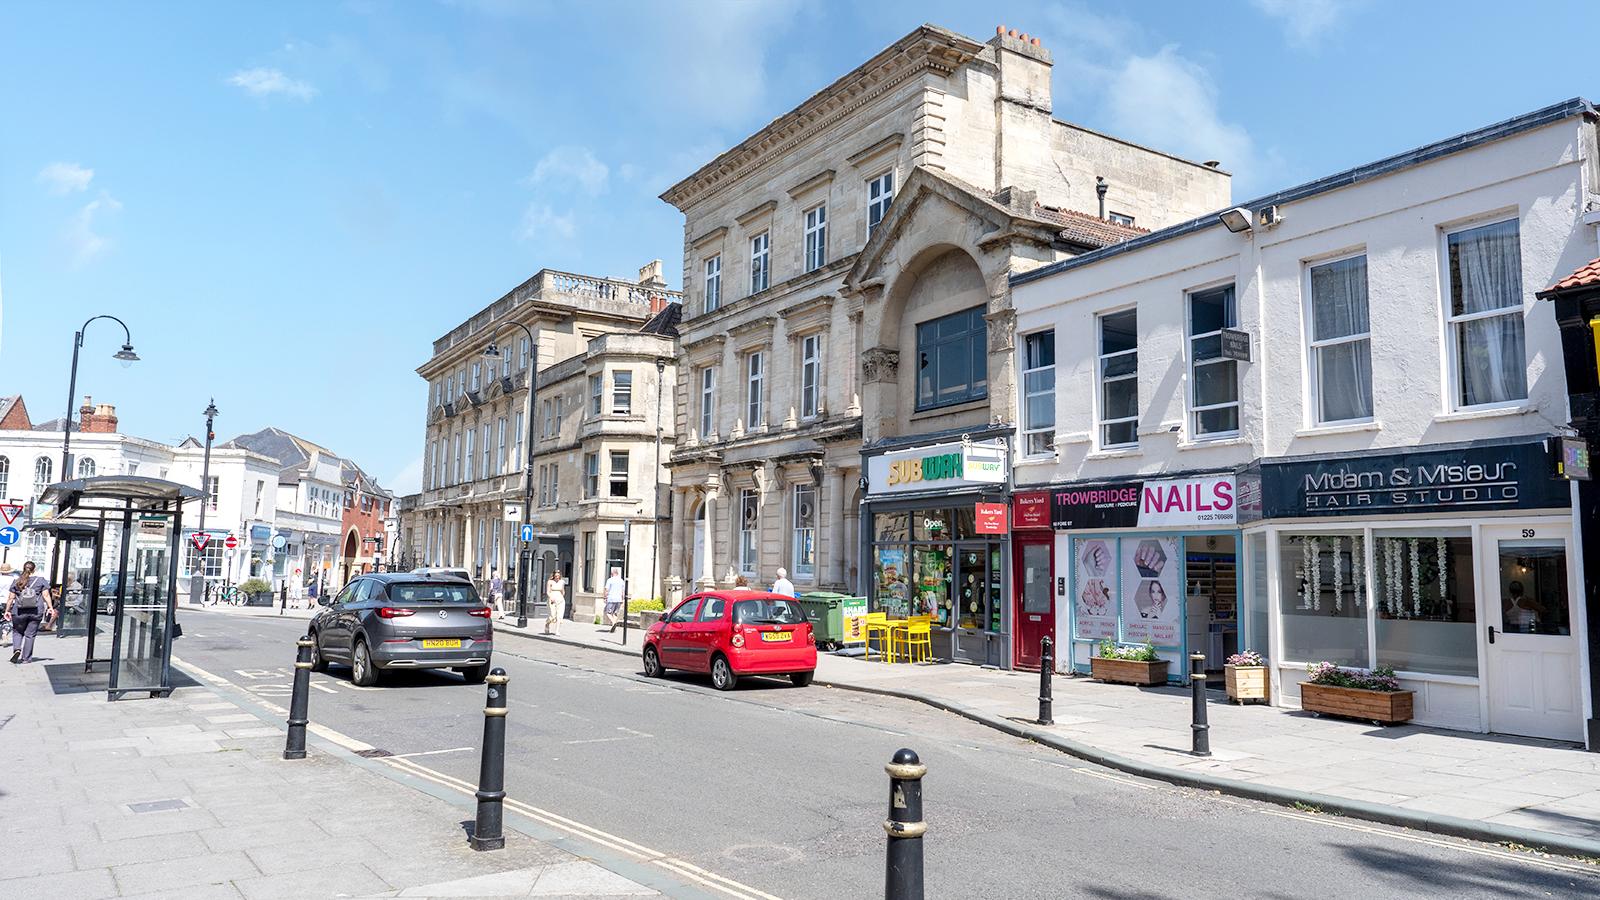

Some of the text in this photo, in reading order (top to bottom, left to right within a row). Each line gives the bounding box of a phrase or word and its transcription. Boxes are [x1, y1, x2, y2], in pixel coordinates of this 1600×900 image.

[1305, 460, 1517, 491] M'dam & M'sieur
[1056, 488, 1137, 505] TROWBRIDGE
[1144, 481, 1234, 514] NAILS
[1306, 486, 1519, 507] HAIR STUDIO
[924, 518, 943, 528] Open
[1522, 529, 1535, 538] 59
